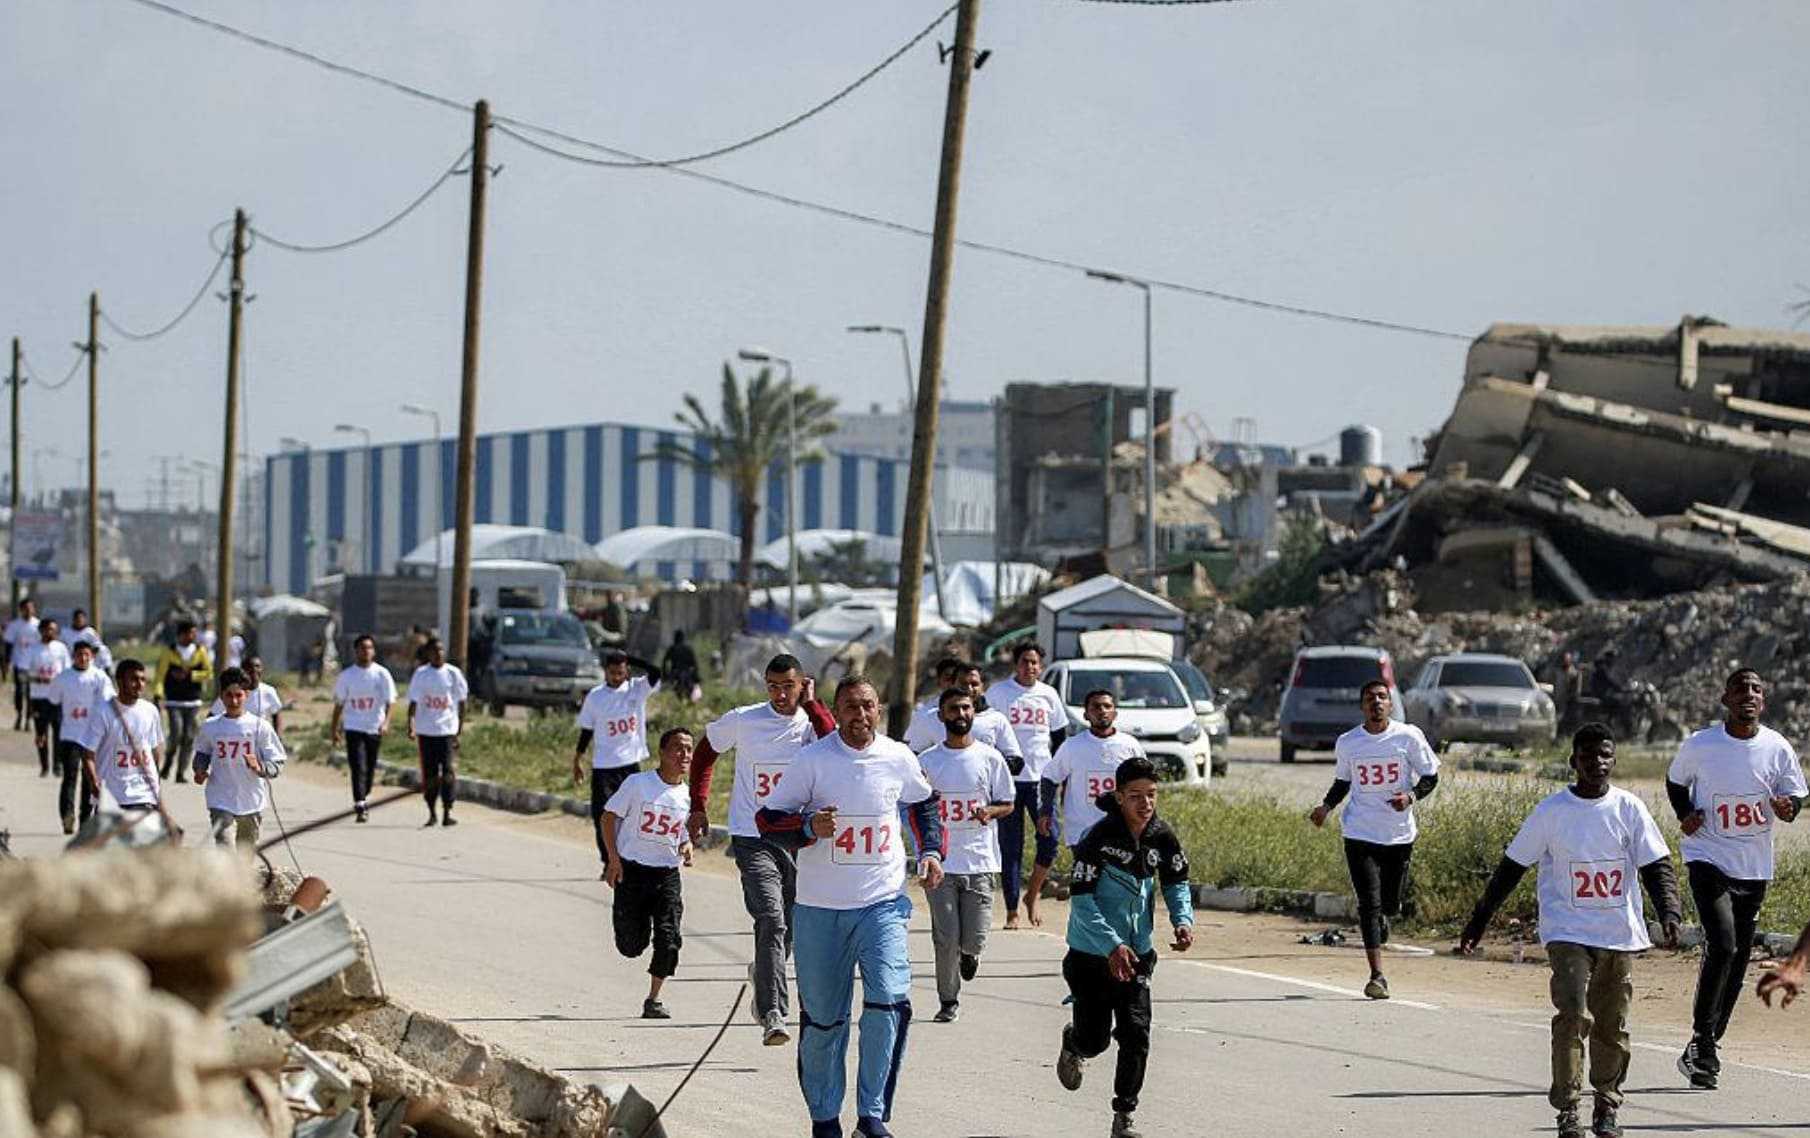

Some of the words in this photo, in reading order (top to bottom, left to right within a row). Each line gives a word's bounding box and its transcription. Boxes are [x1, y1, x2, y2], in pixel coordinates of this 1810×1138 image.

[1010, 707, 1046, 725] 328
[216, 741, 252, 759] 371
[1357, 763, 1400, 785] 335
[640, 811, 682, 838] 254
[834, 825, 891, 854] 412
[1574, 869, 1621, 897] 202
